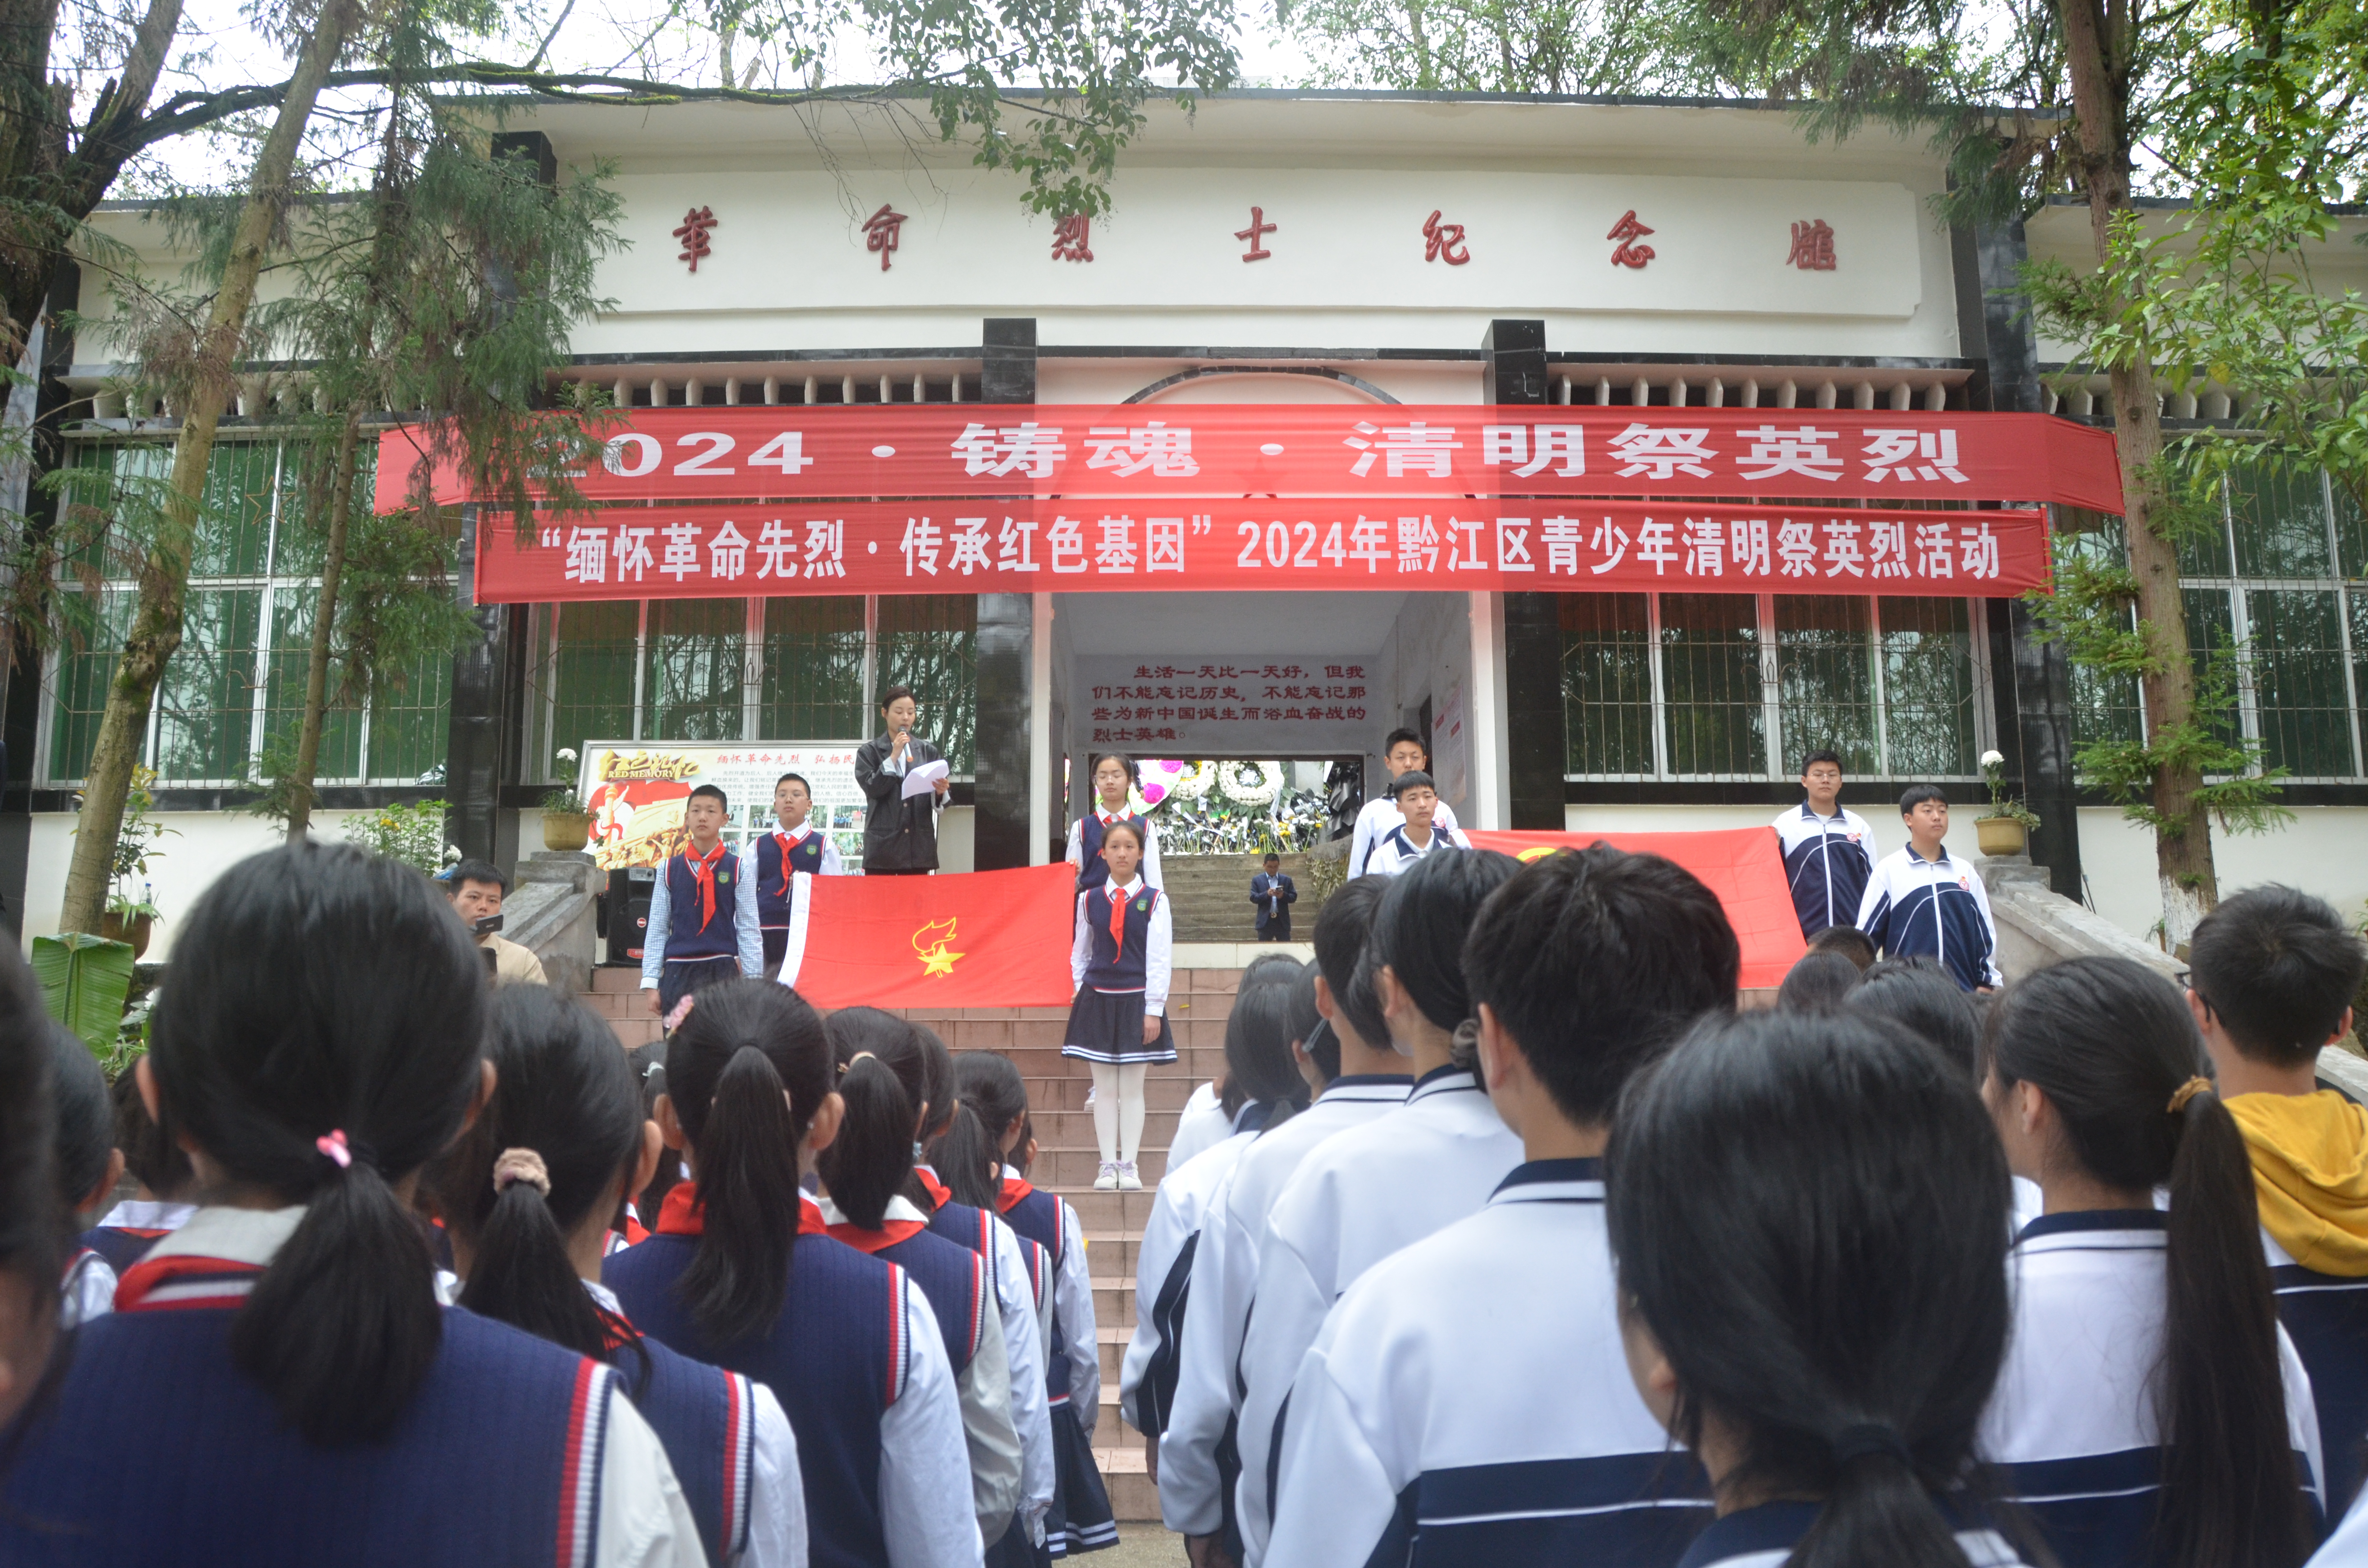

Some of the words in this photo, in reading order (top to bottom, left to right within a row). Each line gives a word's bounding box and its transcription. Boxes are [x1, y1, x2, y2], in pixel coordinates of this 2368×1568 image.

[1134, 665, 1366, 679] 生活一天比一天好，但我
[1092, 685, 1367, 702] 们不能忘记历史，不能忘记那
[1092, 706, 1367, 721] 些为新中国诞生而浴血奋战的
[716, 753, 800, 765] 缅怀革命先烈
[630, 770, 675, 778] MEMORY
